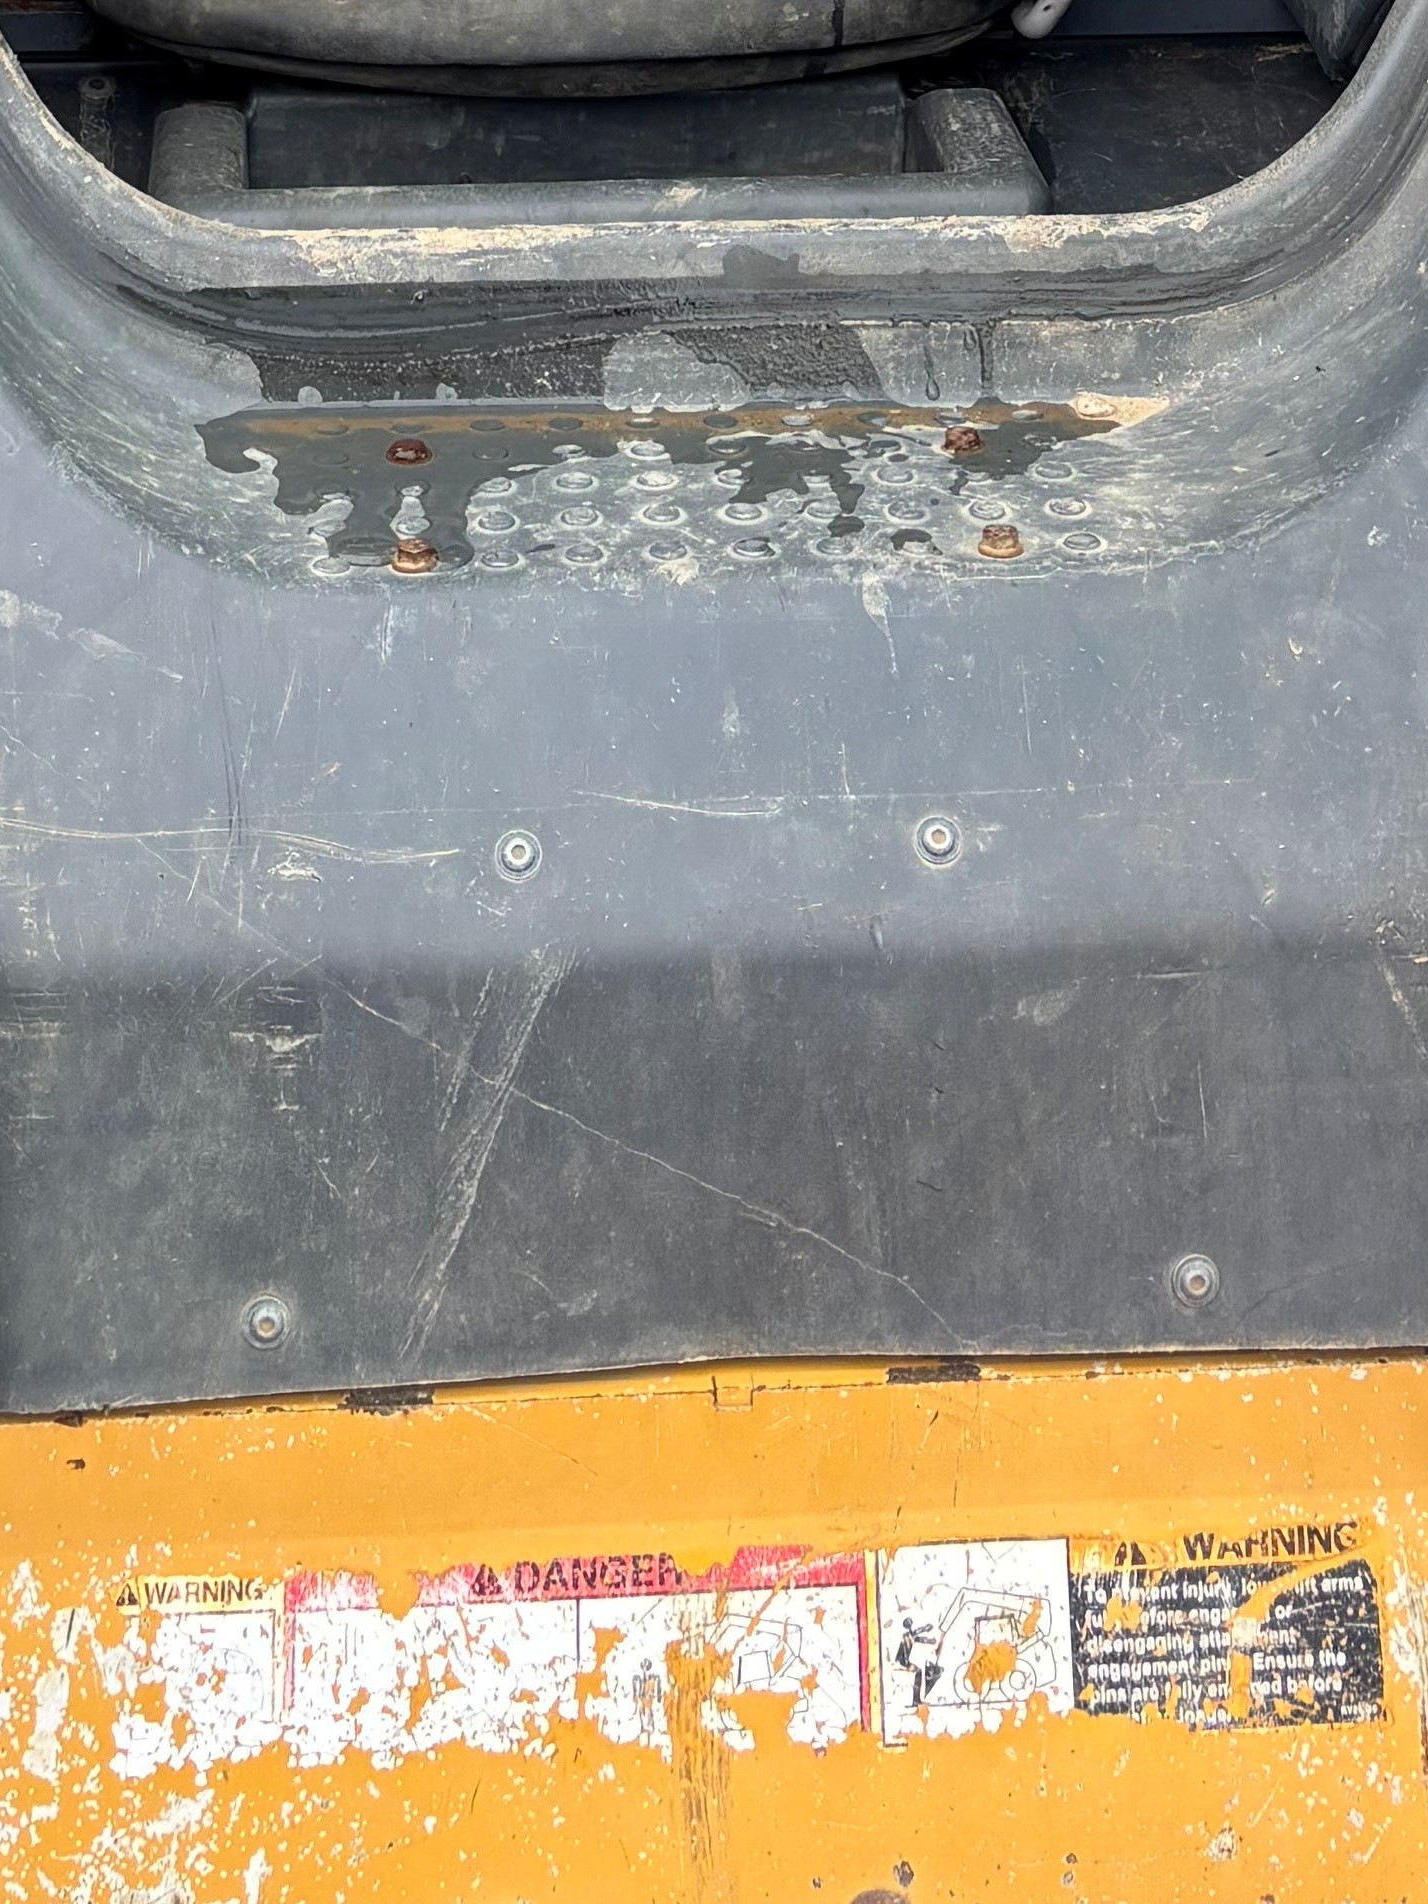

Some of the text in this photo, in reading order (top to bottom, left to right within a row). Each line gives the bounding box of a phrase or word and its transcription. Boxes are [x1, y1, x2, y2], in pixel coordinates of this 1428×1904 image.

[1183, 1521, 1358, 1562] WARNING
[515, 1552, 683, 1592] DANGER
[1321, 1575, 1365, 1593] arms
[144, 1578, 264, 1605] WARNING
[1134, 1605, 1187, 1629] efore
[1252, 1651, 1315, 1671] Ensure
[1319, 1649, 1347, 1667] the
